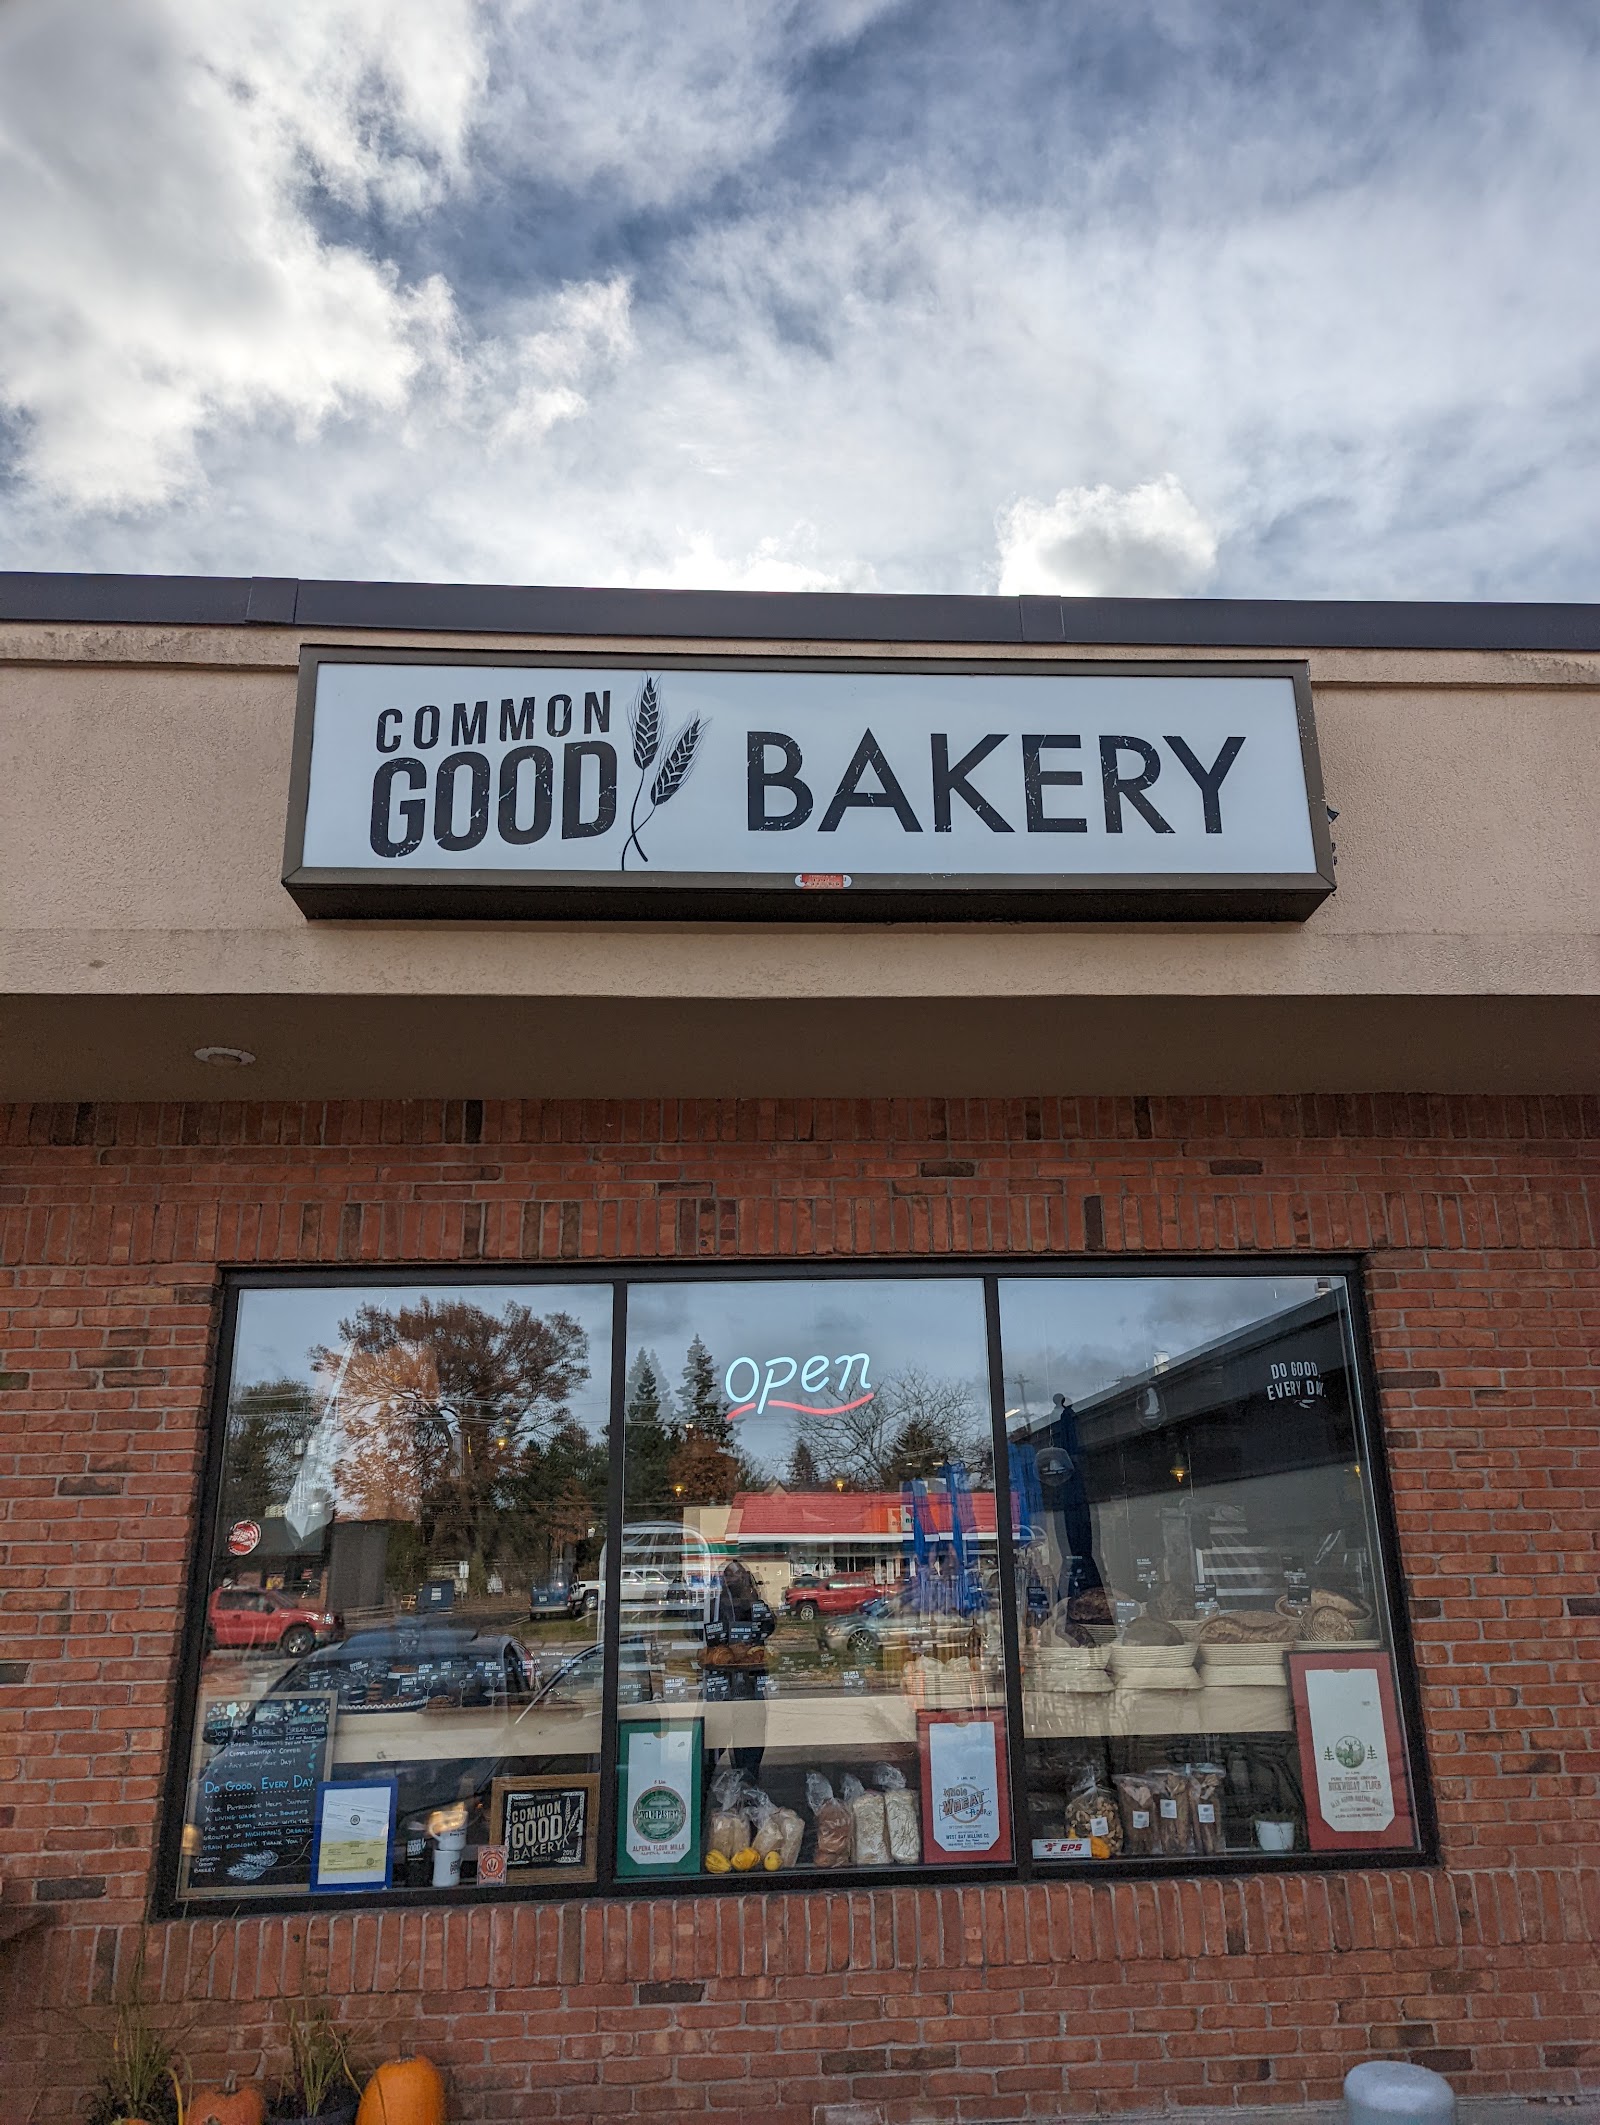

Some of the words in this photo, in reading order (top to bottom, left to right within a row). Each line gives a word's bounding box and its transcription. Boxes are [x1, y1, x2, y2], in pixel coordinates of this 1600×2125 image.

[376, 690, 611, 753] COMMON
[746, 728, 1247, 834] BAKERY
[370, 741, 617, 858] GOOD
[1270, 1363, 1287, 1379] DO
[1291, 1361, 1321, 1379] GOOD,
[1267, 1380, 1301, 1401] EVERY
[512, 1801, 561, 1823] COMMON
[511, 1815, 563, 1849] GOOD
[513, 1840, 563, 1861] BAKERY
[1060, 1844, 1083, 1852] EPS
